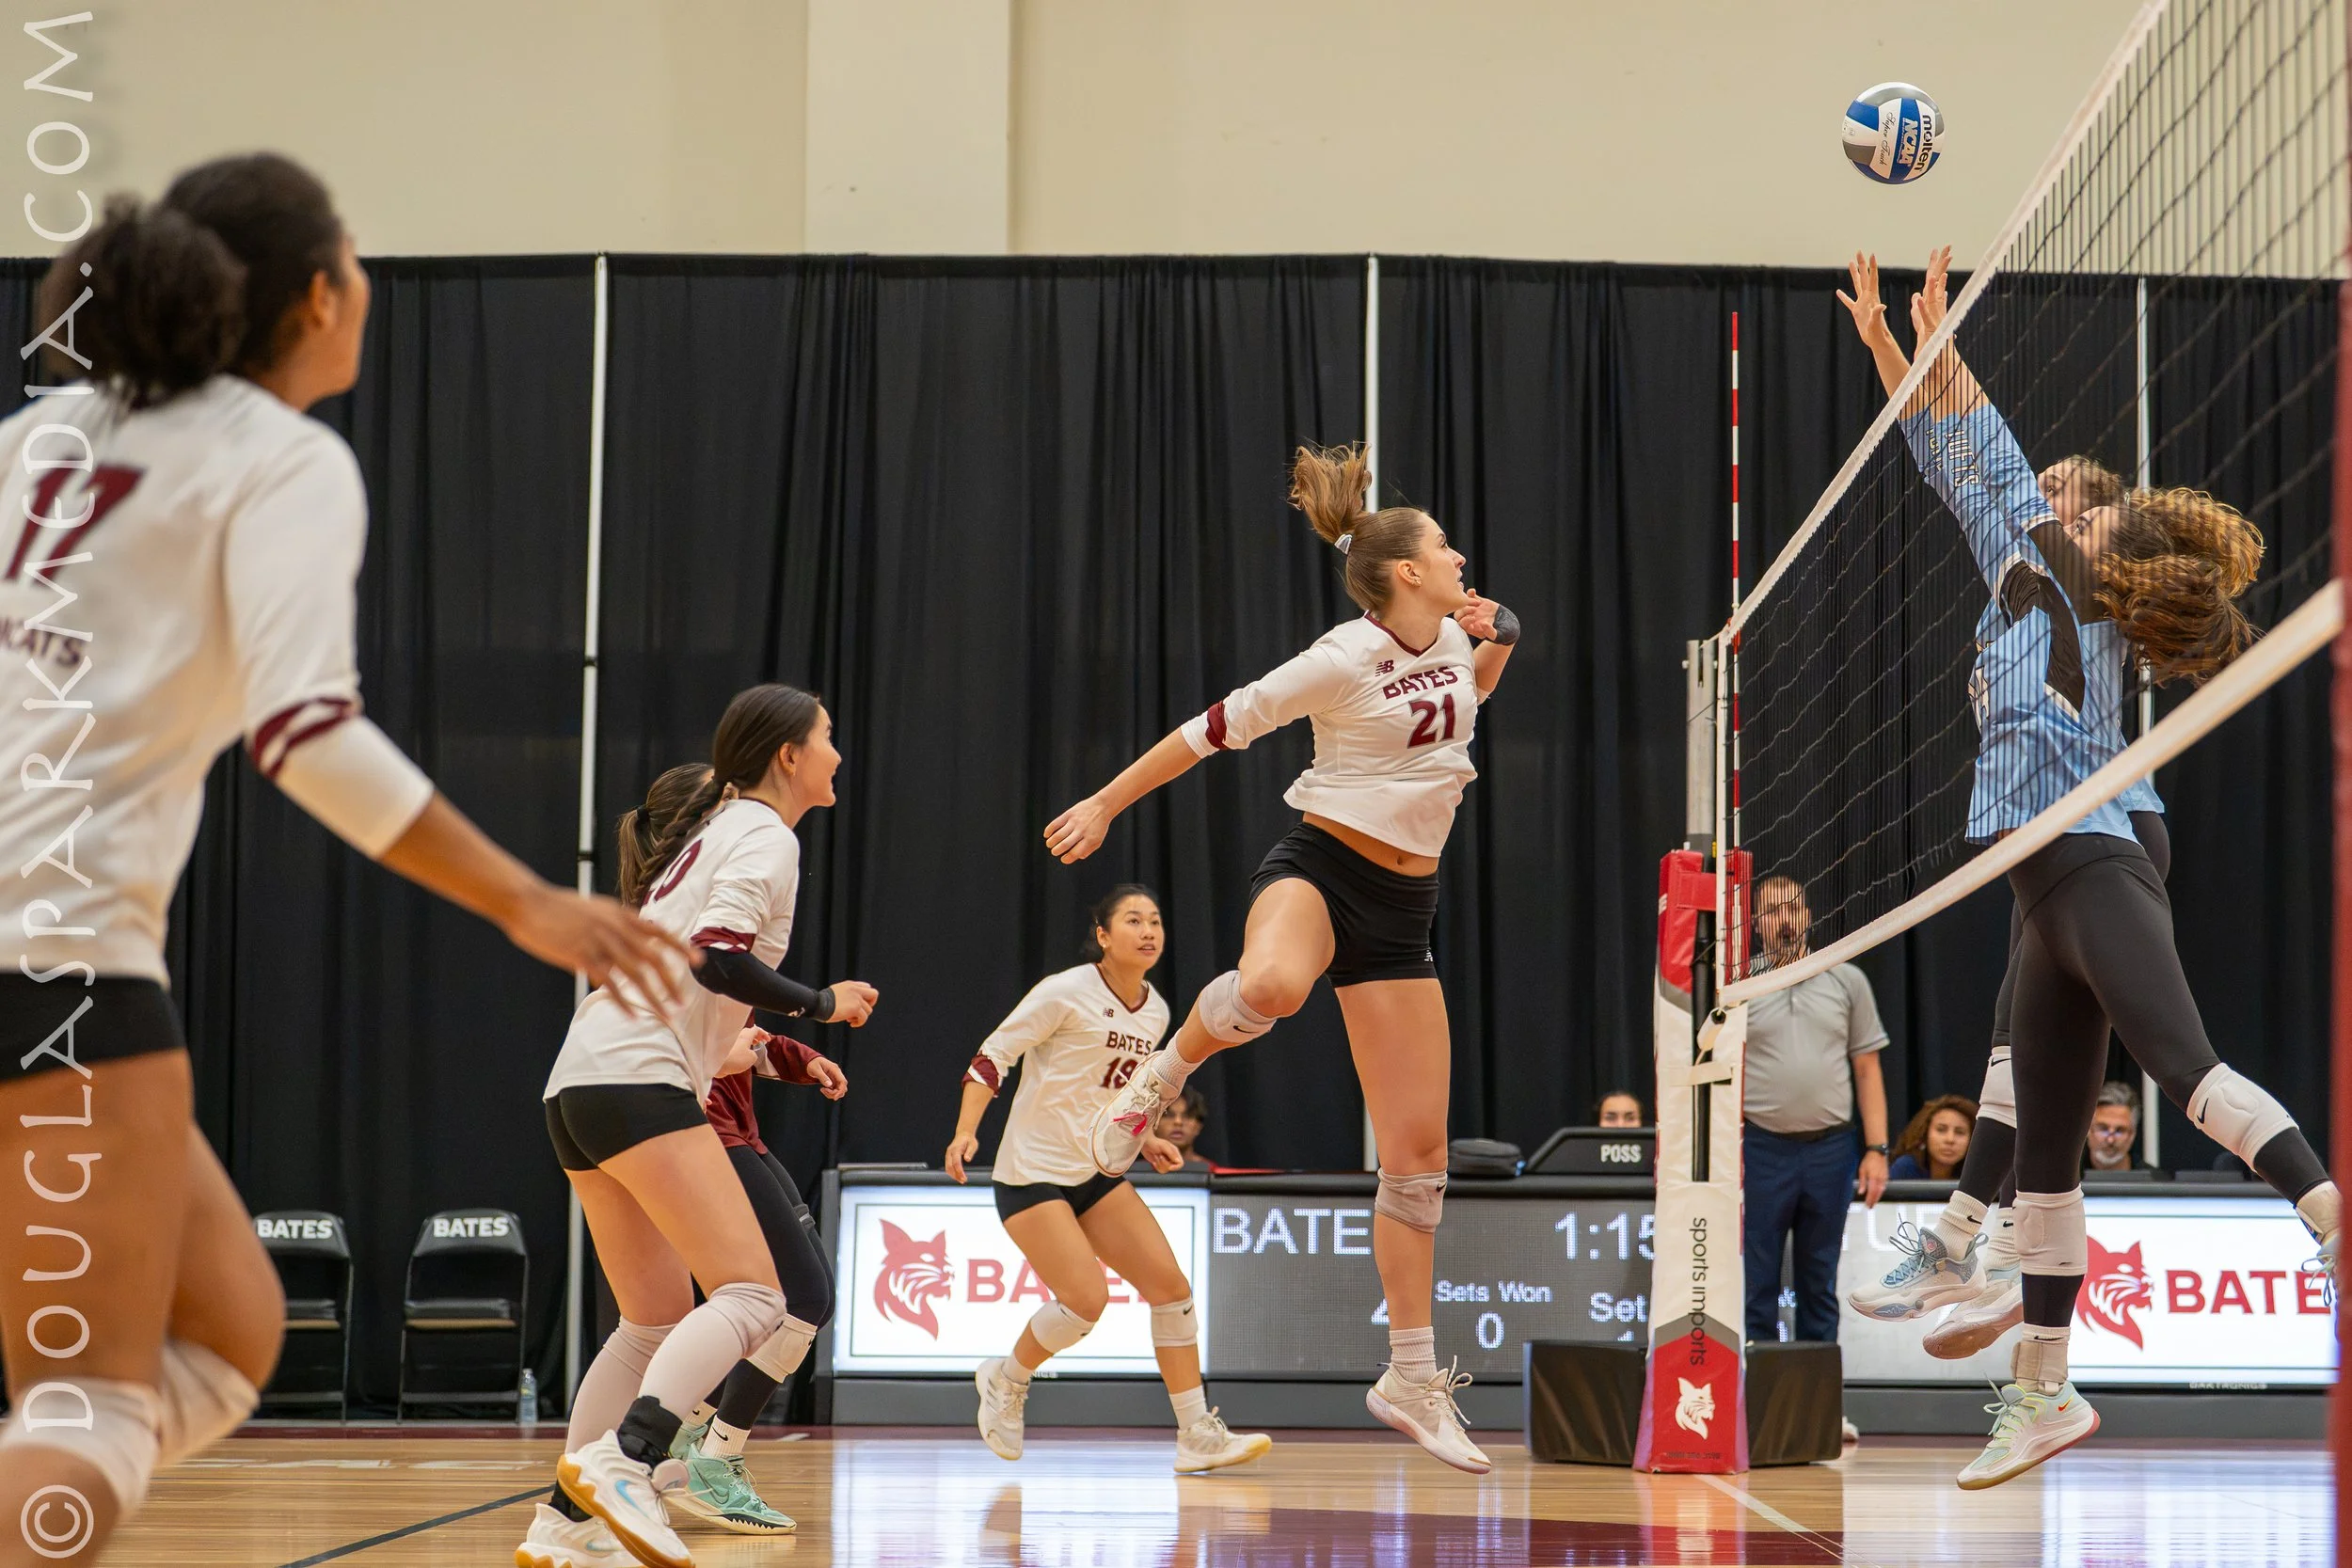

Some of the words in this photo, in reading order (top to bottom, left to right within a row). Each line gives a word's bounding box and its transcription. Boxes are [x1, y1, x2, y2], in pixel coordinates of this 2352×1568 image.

[1897, 117, 1918, 166] NCAA
[1914, 114, 1933, 171] molten
[4, 456, 147, 588] 17
[0, 616, 85, 666] CATS
[1382, 666, 1459, 700] BATES
[1406, 692, 1456, 749] 21
[1105, 1031, 1152, 1055] BATES
[1600, 1144, 1642, 1163] POSS
[256, 1218, 333, 1239] BATES
[432, 1217, 509, 1237] BATES
[1214, 1208, 1372, 1255] BATE
[1689, 1217, 1709, 1282] sports
[967, 1259, 1149, 1303] BAE
[1435, 1280, 1490, 1303] Sets
[1498, 1280, 1553, 1303] Won
[2166, 1270, 2331, 1315] BATE
[1589, 1292, 1648, 1323] Set
[1687, 1287, 1708, 1366] imports
[1476, 1311, 1505, 1351] 0
